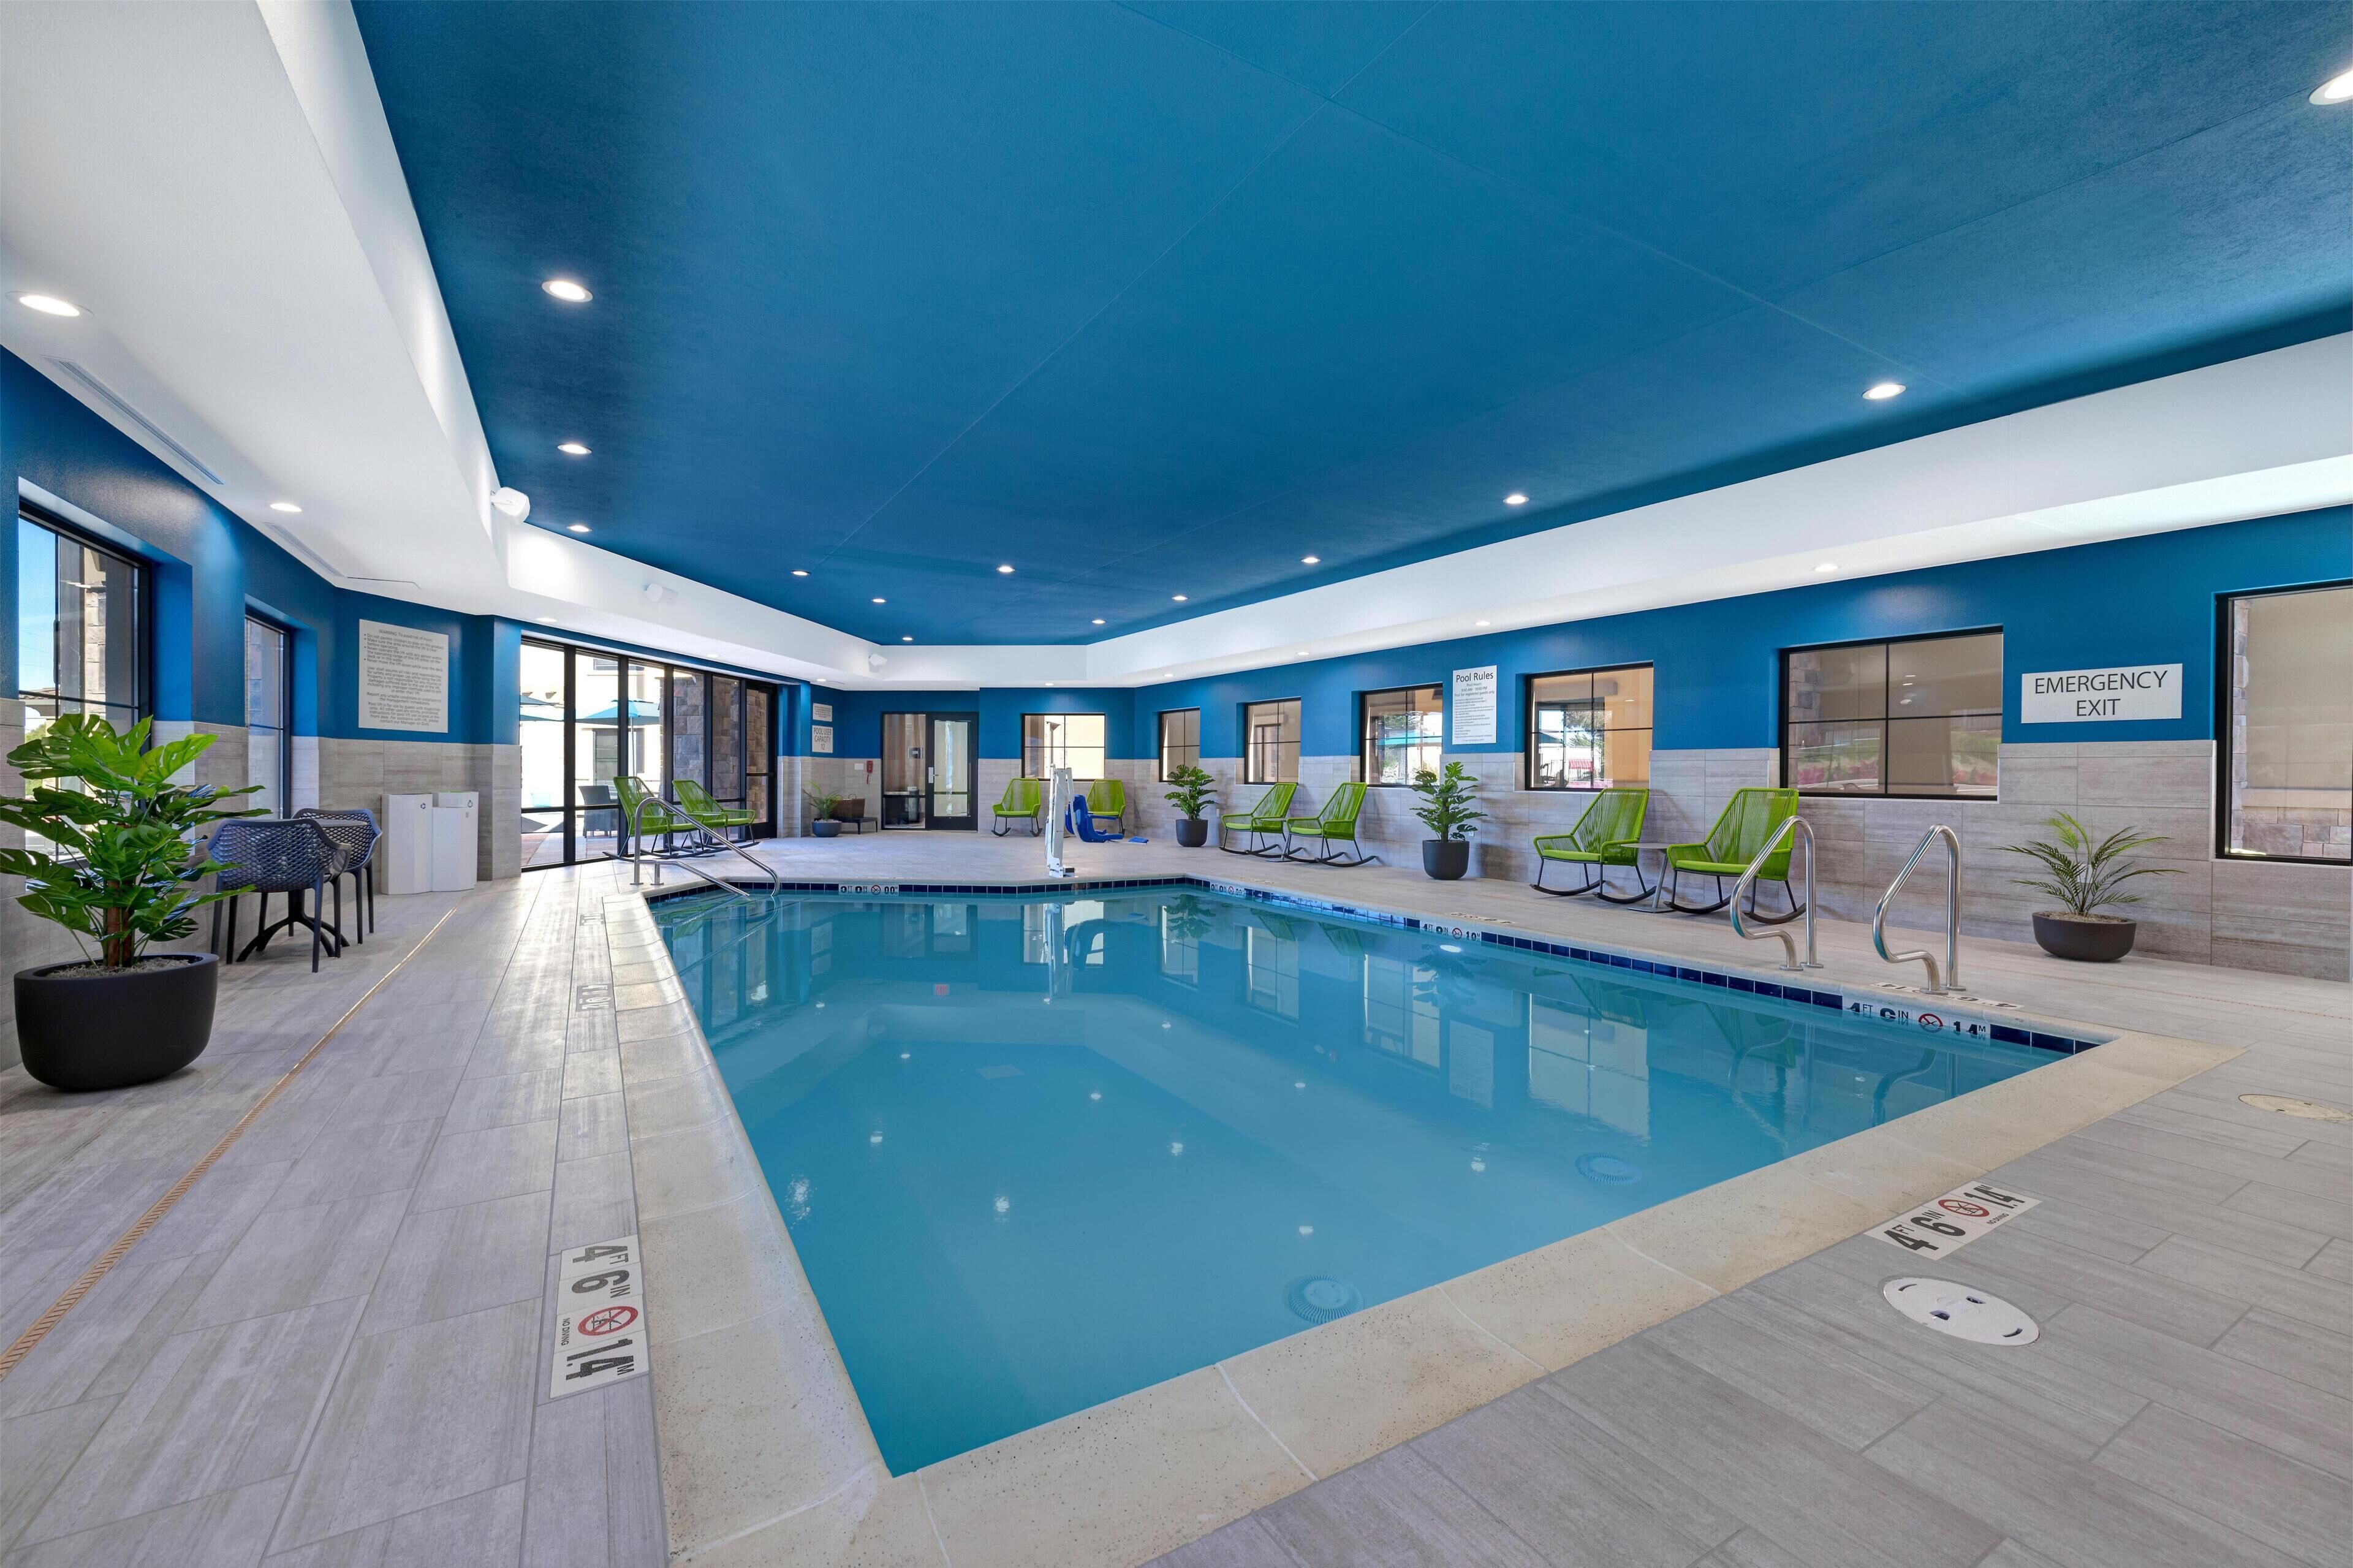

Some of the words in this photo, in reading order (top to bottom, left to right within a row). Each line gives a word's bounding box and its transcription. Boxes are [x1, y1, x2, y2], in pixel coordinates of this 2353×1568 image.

[1456, 673, 1471, 683] Pool
[1474, 671, 1493, 681] Rules
[2035, 671, 2168, 694] EMERGENCY
[2076, 699, 2121, 716] EXIT
[1863, 1004, 1873, 1012] FT
[1898, 1010, 1908, 1019] IN
[1922, 1210, 1945, 1220] IN
[1992, 1213, 2009, 1221] DIVING
[1892, 1224, 1914, 1234] FT
[1910, 1217, 1966, 1237] 6
[1884, 1229, 1939, 1251] 4
[573, 1246, 628, 1263] 4
[609, 1253, 629, 1265] FT
[572, 1269, 630, 1294] 6
[610, 1284, 631, 1298] IN
[562, 1318, 570, 1326] NO
[561, 1327, 570, 1346] DIVING
